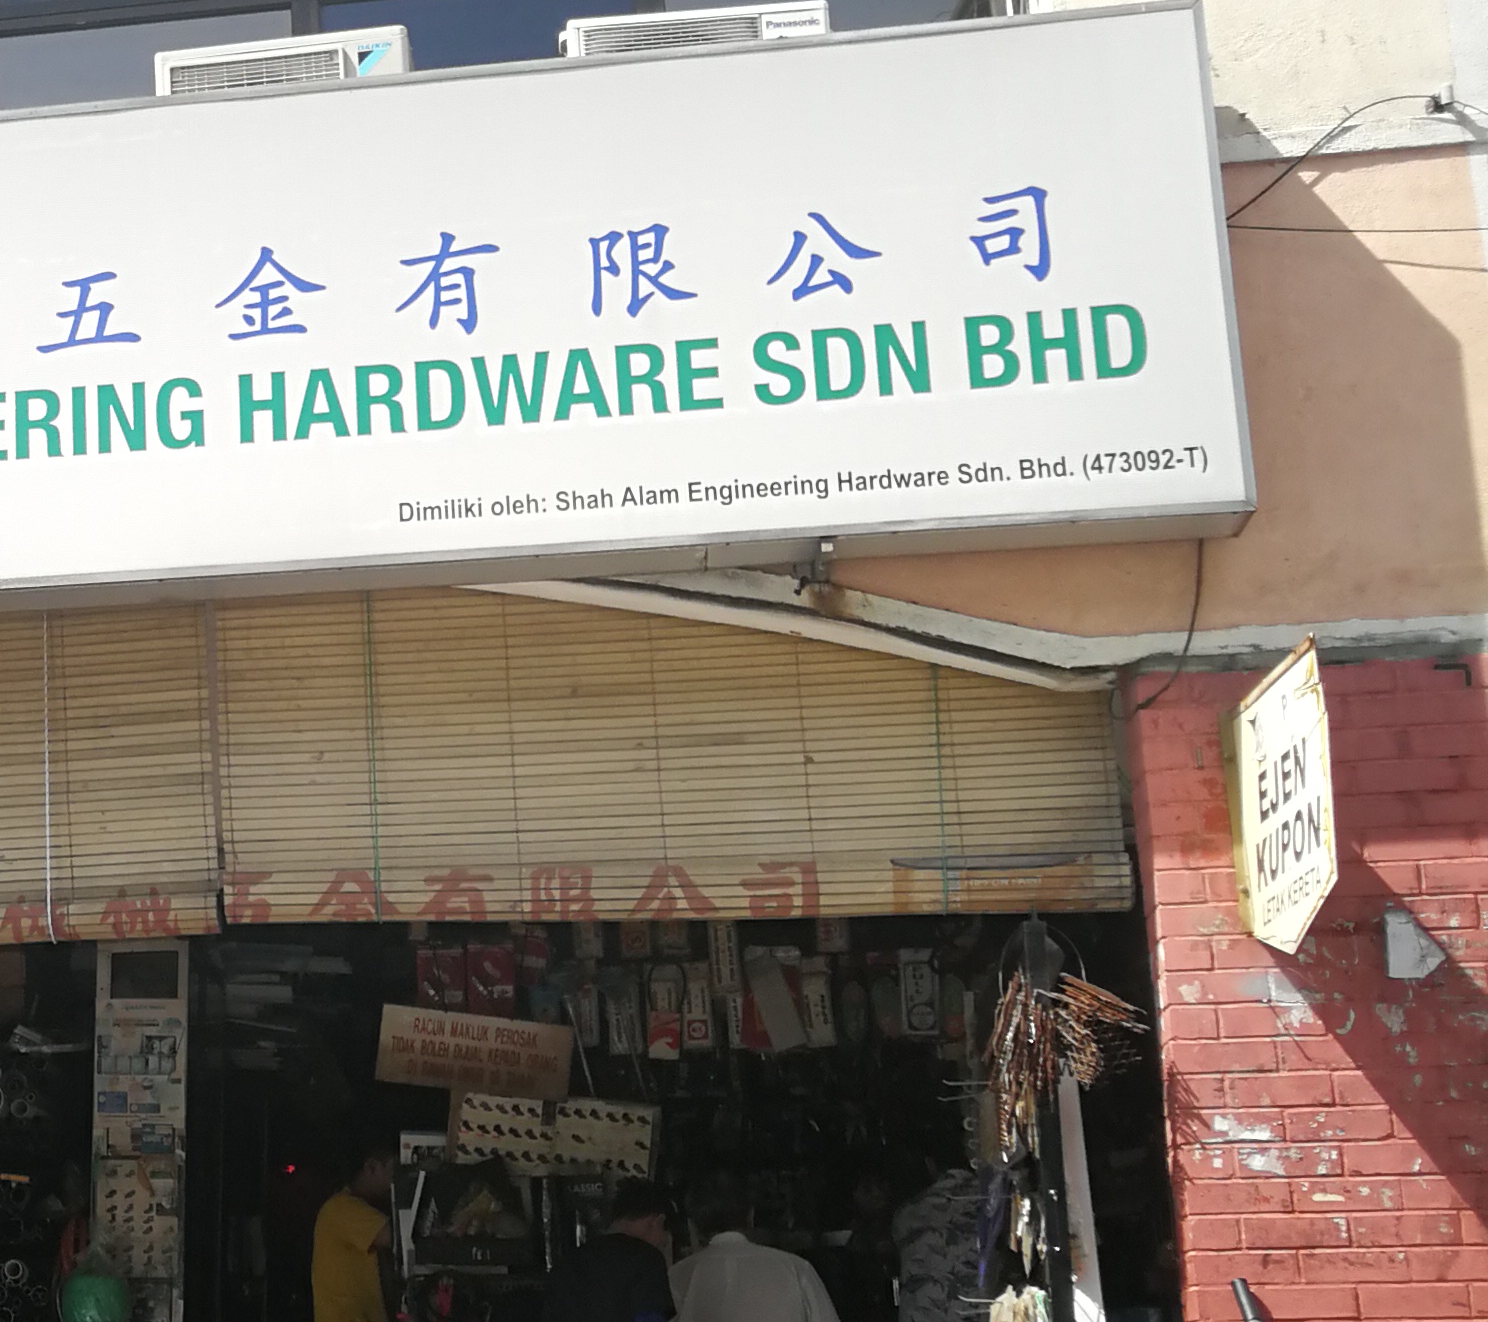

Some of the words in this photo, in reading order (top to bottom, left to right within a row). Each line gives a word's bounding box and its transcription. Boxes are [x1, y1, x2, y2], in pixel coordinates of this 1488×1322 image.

[765, 17, 820, 29] Panasonic
[239, 338, 724, 444] HARDWARE
[753, 321, 930, 406] SDN
[965, 304, 1147, 389] BHD
[398, 497, 483, 523] Dimiliki
[491, 494, 547, 517] oleh:
[555, 488, 614, 512] Shah
[621, 484, 680, 508] Alam
[687, 476, 830, 504] Engineering
[837, 468, 950, 493] Hardware
[957, 461, 1013, 485] Sdn.
[1019, 456, 1076, 481] Bhd.
[1081, 445, 1210, 481] (473092-T)
[1257, 737, 1307, 825] EJEN
[1255, 795, 1322, 893] KUPON
[1262, 891, 1287, 926] LETAK
[1287, 865, 1322, 910] KERETA
[391, 1035, 415, 1055] TIDAK
[420, 1038, 450, 1059] BOLEH
[412, 1017, 446, 1037] RACUN
